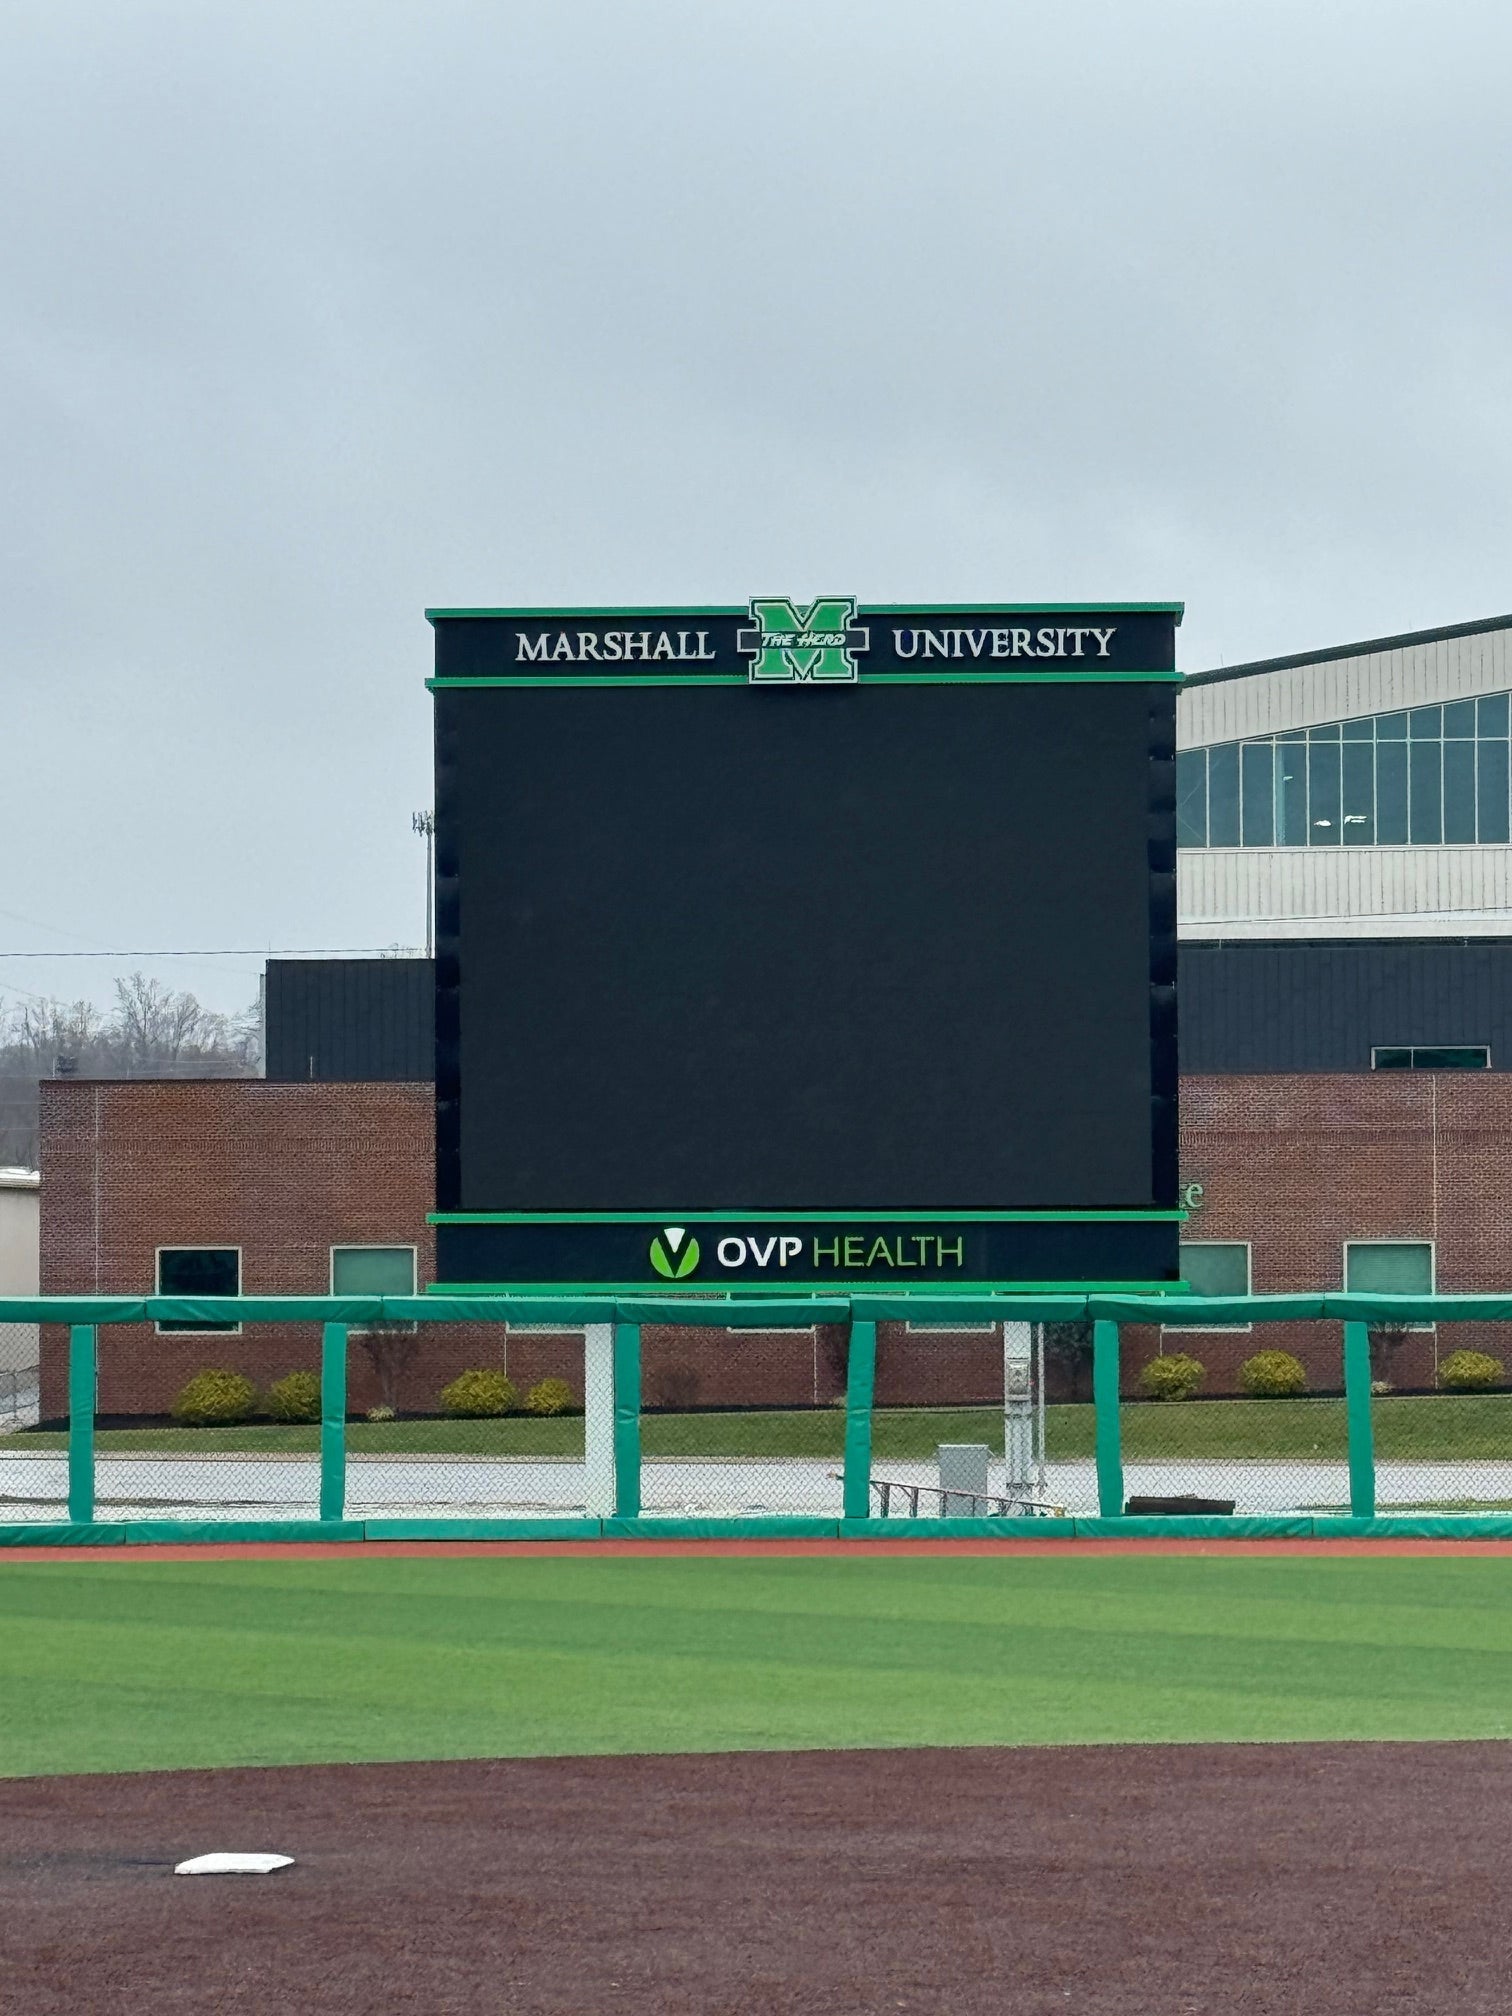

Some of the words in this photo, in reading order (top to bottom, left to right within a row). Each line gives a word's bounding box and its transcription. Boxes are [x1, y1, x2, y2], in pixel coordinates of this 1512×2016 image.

[515, 631, 716, 661] MARSHALL
[892, 627, 1116, 659] UNIVERSITY
[761, 632, 794, 647] THE
[717, 1236, 802, 1267] OVP
[813, 1235, 963, 1267] HEALTH
